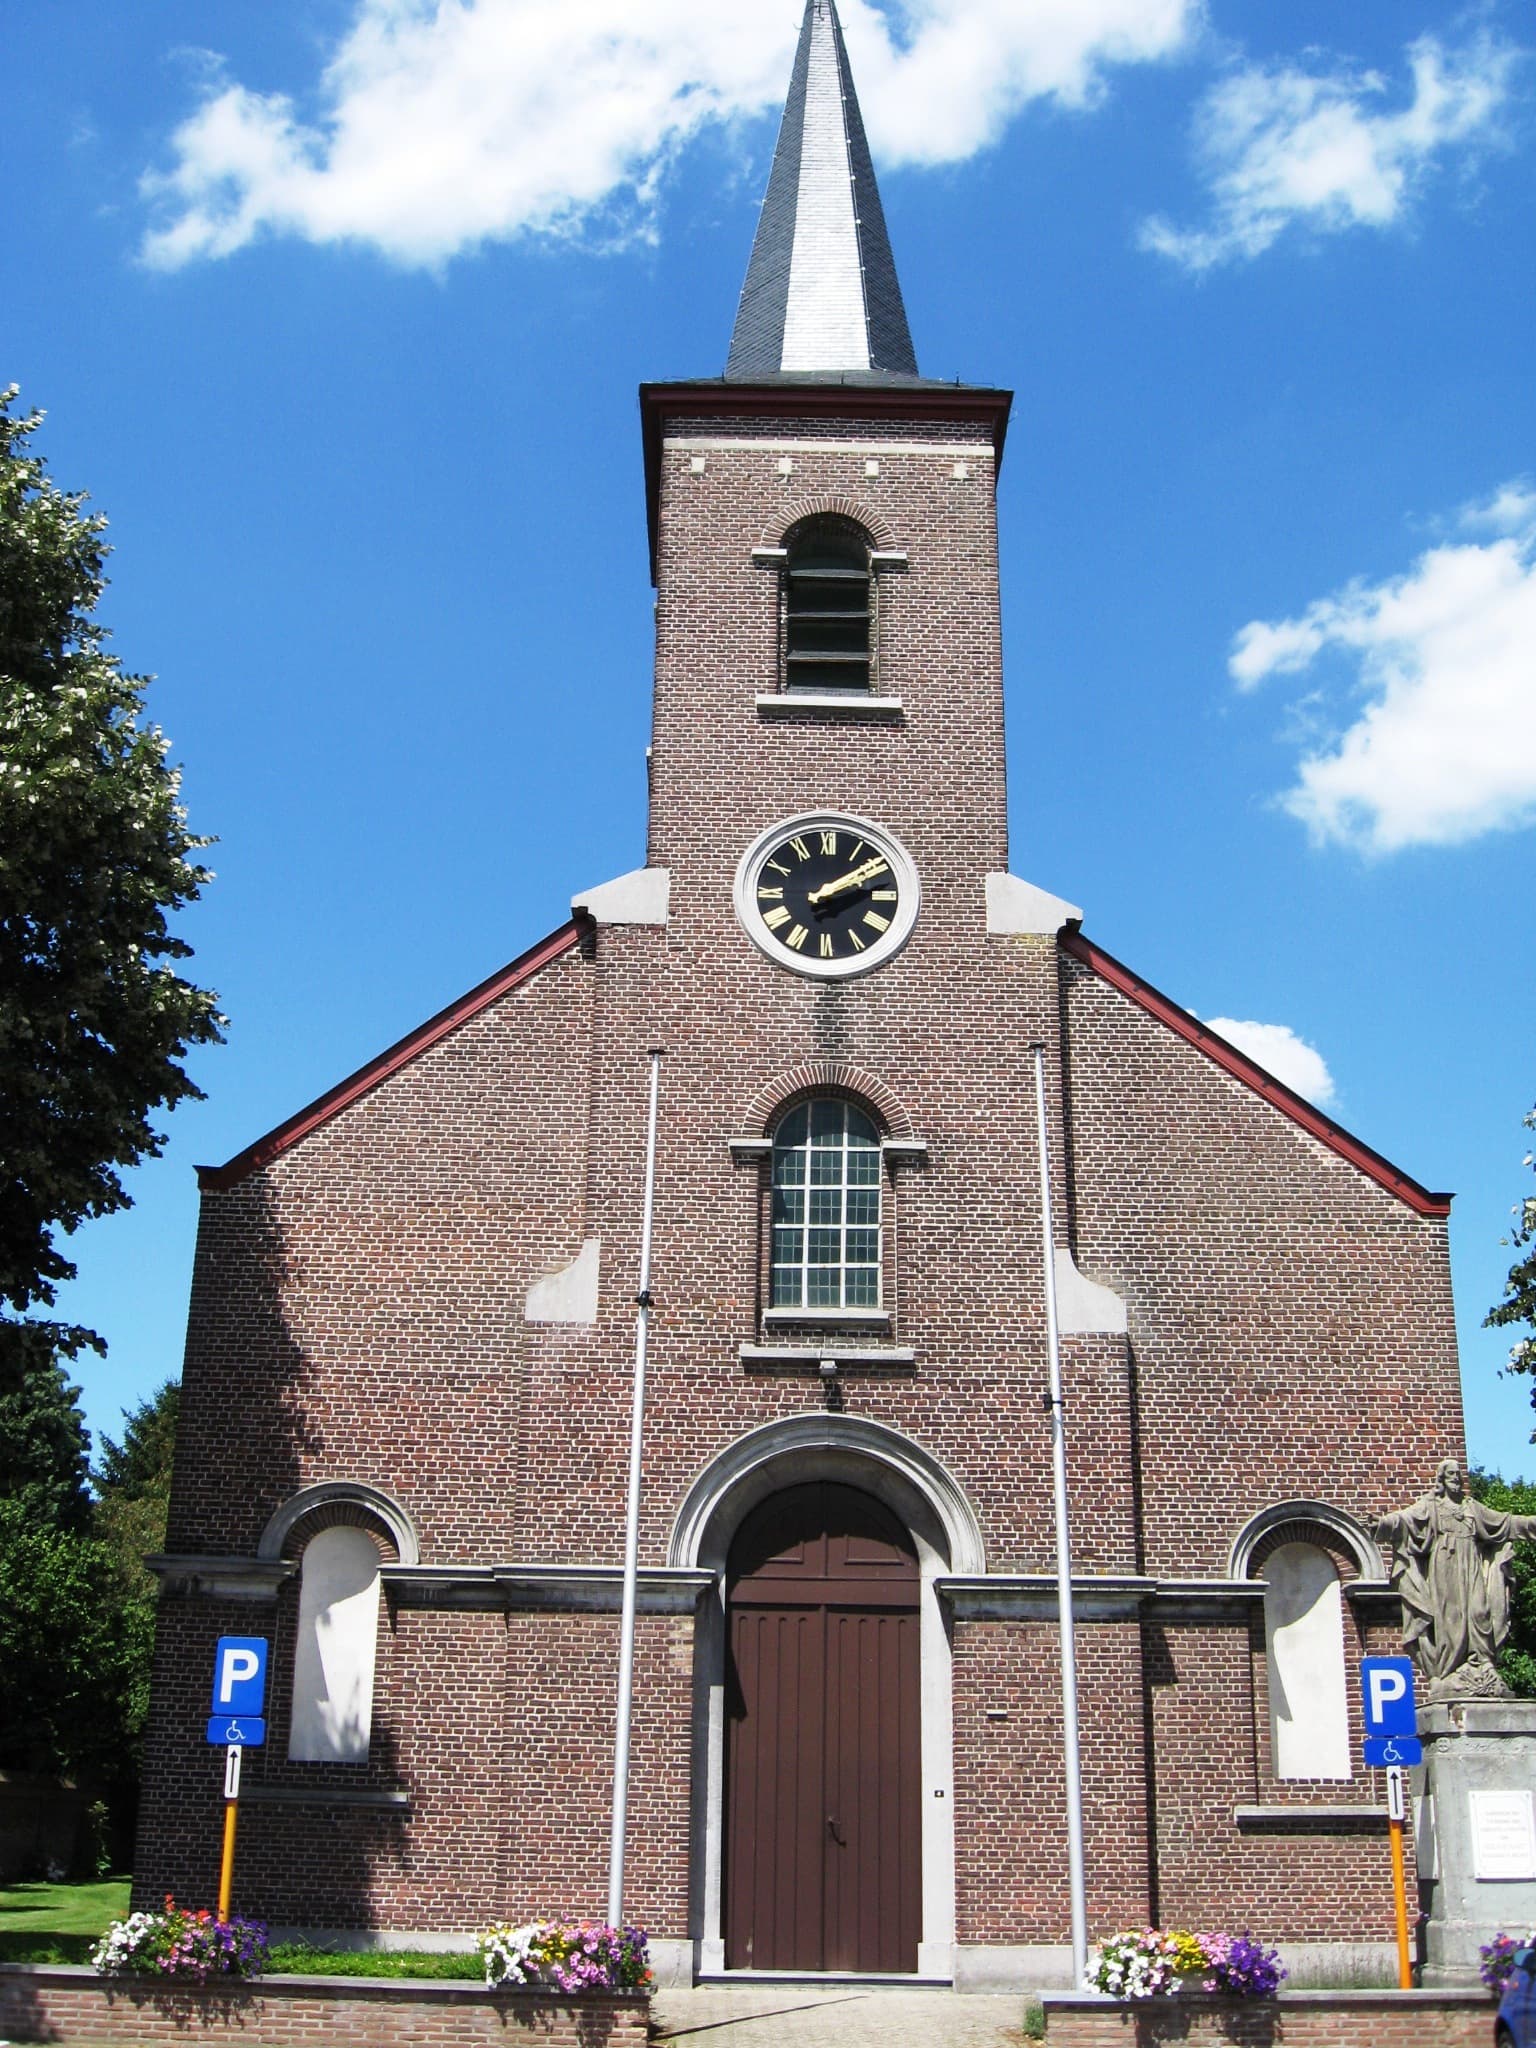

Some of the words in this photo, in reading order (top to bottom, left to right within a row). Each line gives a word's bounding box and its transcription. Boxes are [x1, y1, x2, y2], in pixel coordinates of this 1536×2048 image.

[789, 836, 811, 862] XI
[820, 832, 836, 855] XII
[766, 859, 791, 877] X
[757, 887, 783, 899] IX
[871, 890, 897, 901] III
[762, 905, 792, 931] VIII
[785, 923, 809, 950] VII
[820, 933, 833, 957] VI
[848, 928, 865, 951] V
[220, 1649, 259, 1702] P
[1369, 1669, 1406, 1723] P
